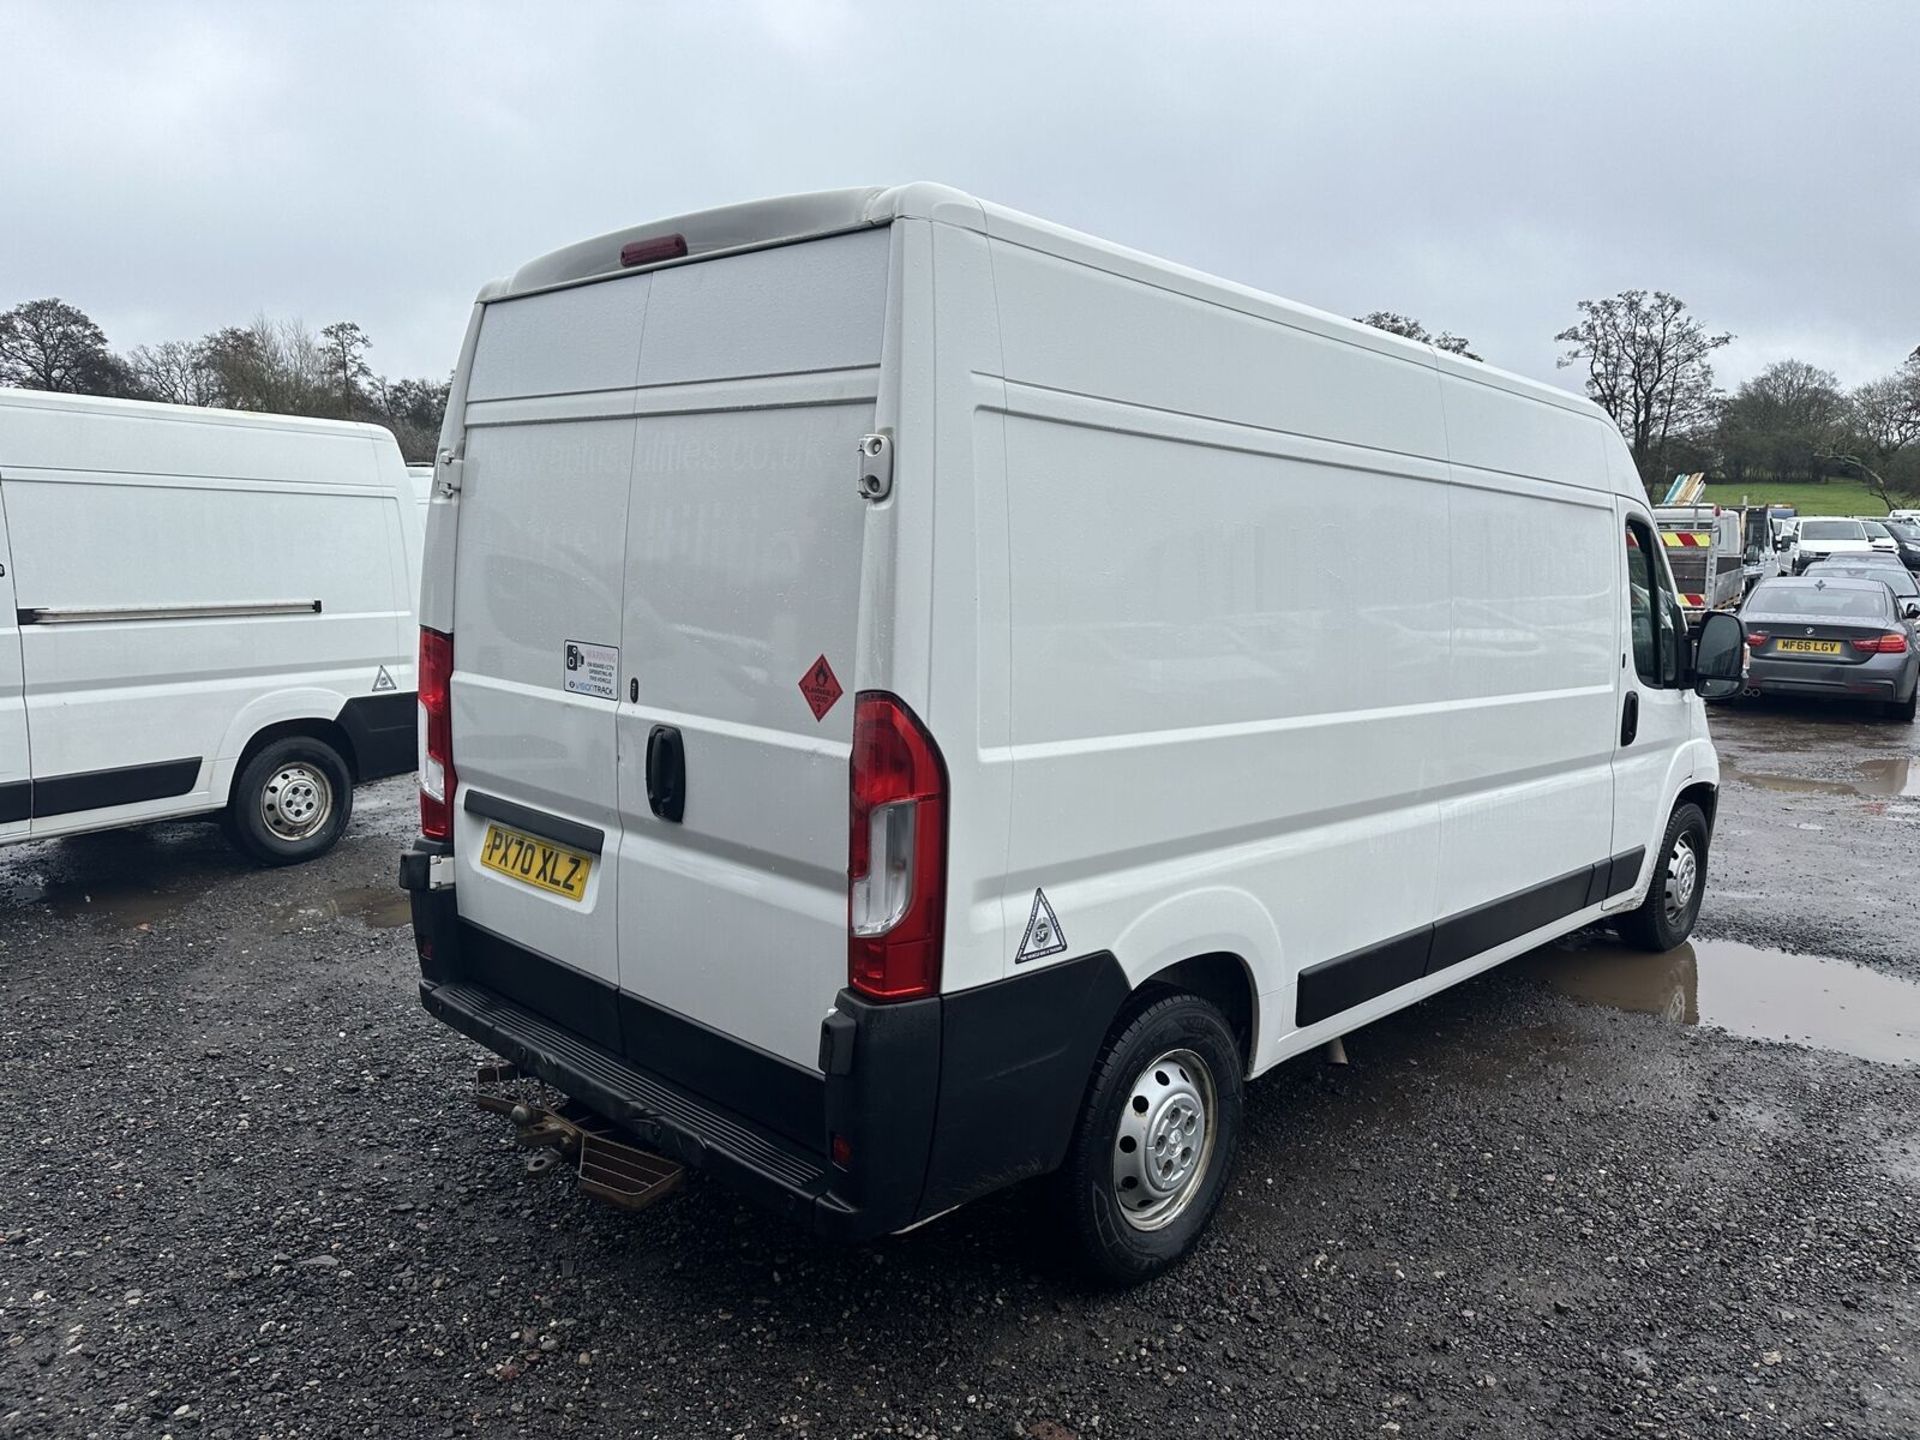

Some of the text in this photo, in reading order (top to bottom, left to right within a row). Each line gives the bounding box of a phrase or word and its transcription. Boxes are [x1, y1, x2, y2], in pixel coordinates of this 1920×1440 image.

[1782, 640, 1836, 652] MF66 LGV
[488, 831, 581, 891] PX70 XLZ
